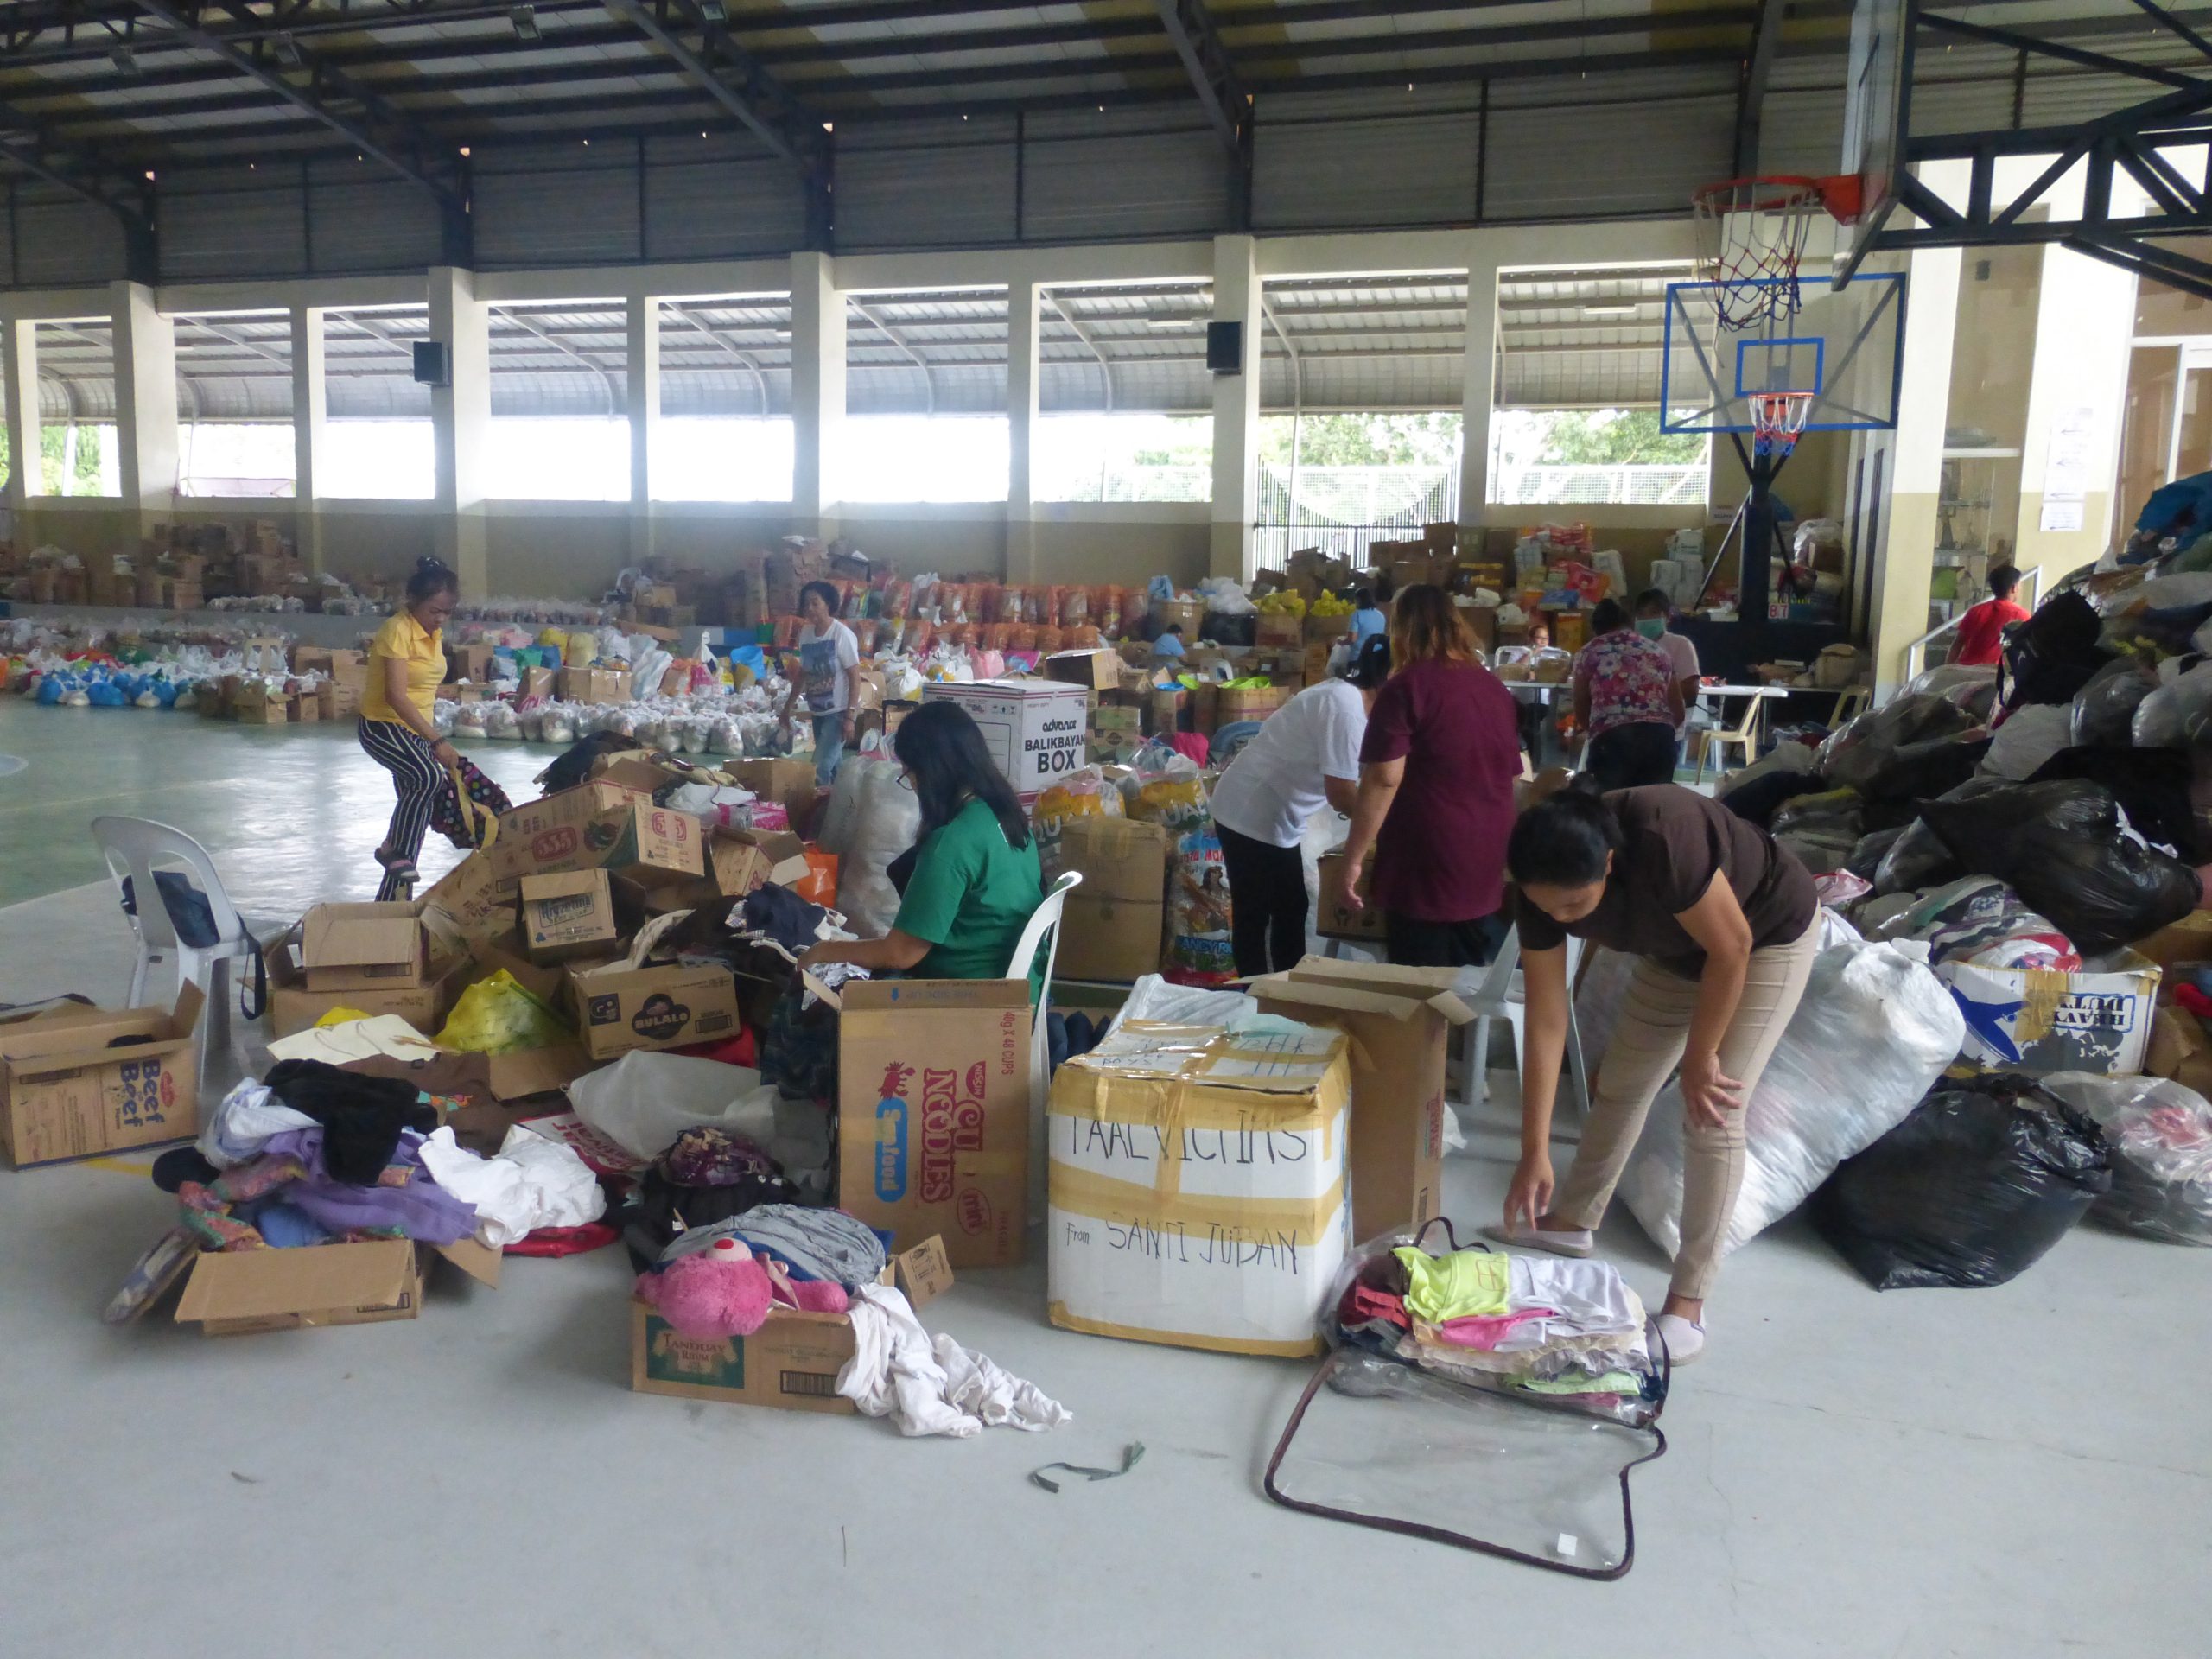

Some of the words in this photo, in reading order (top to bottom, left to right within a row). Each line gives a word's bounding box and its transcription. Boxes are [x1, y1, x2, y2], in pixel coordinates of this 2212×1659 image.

[1042, 719, 1077, 733] advance
[1024, 734, 1085, 752] BALIKBAYAN
[1037, 748, 1077, 774] BOX
[634, 1013, 689, 1029] BULALO
[1000, 1011, 1016, 1028] 40g
[1001, 1050, 1016, 1076] CUPS
[142, 1058, 166, 1124] Beef
[971, 1064, 984, 1096] NISSIN
[120, 1062, 143, 1128] Beef
[922, 1068, 956, 1203] NOODLES
[881, 1109, 902, 1192] Safood
[961, 1193, 987, 1230] mini
[1065, 1221, 1090, 1246] From
[663, 1332, 726, 1353] TANDUAY
